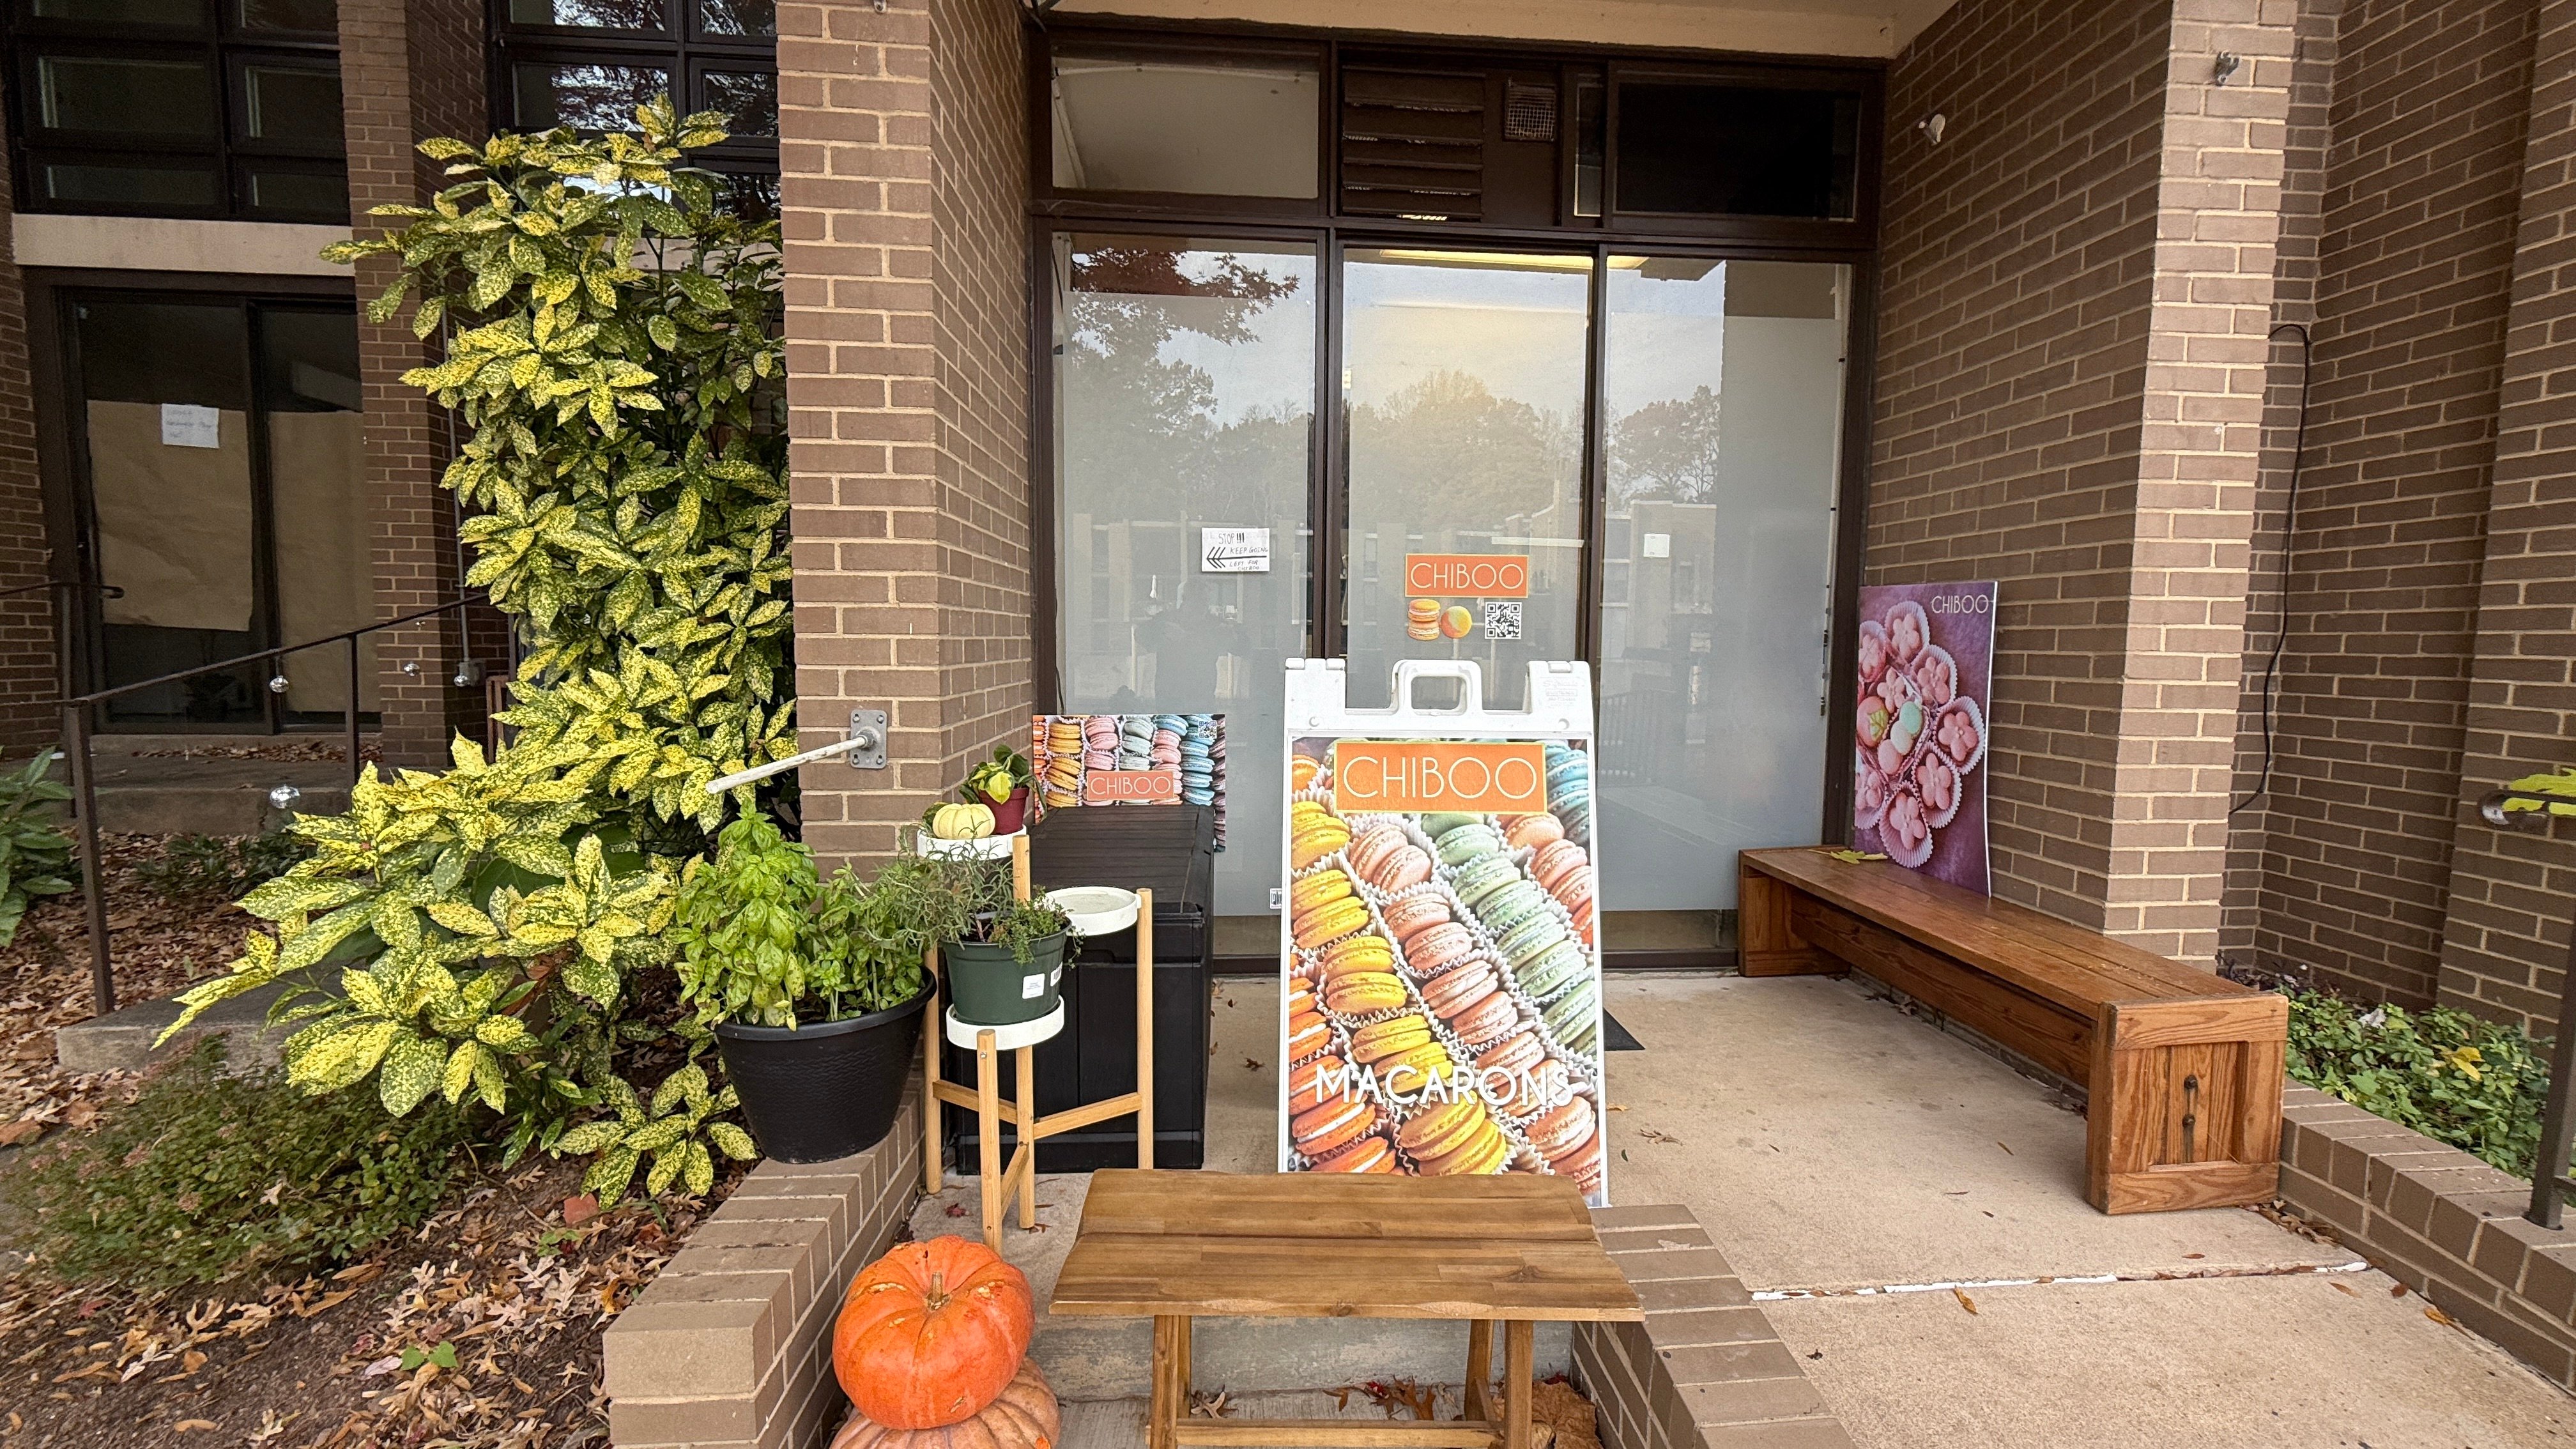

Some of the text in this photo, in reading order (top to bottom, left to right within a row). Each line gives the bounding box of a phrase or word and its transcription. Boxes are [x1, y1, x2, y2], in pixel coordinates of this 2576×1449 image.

[1410, 562, 1524, 590] CHIBOO
[1931, 594, 1989, 612] CHIBOO
[1090, 776, 1172, 795] CHIBOO
[1343, 756, 1537, 799] CHIBOO
[1315, 1064, 1574, 1107] MACARONS
